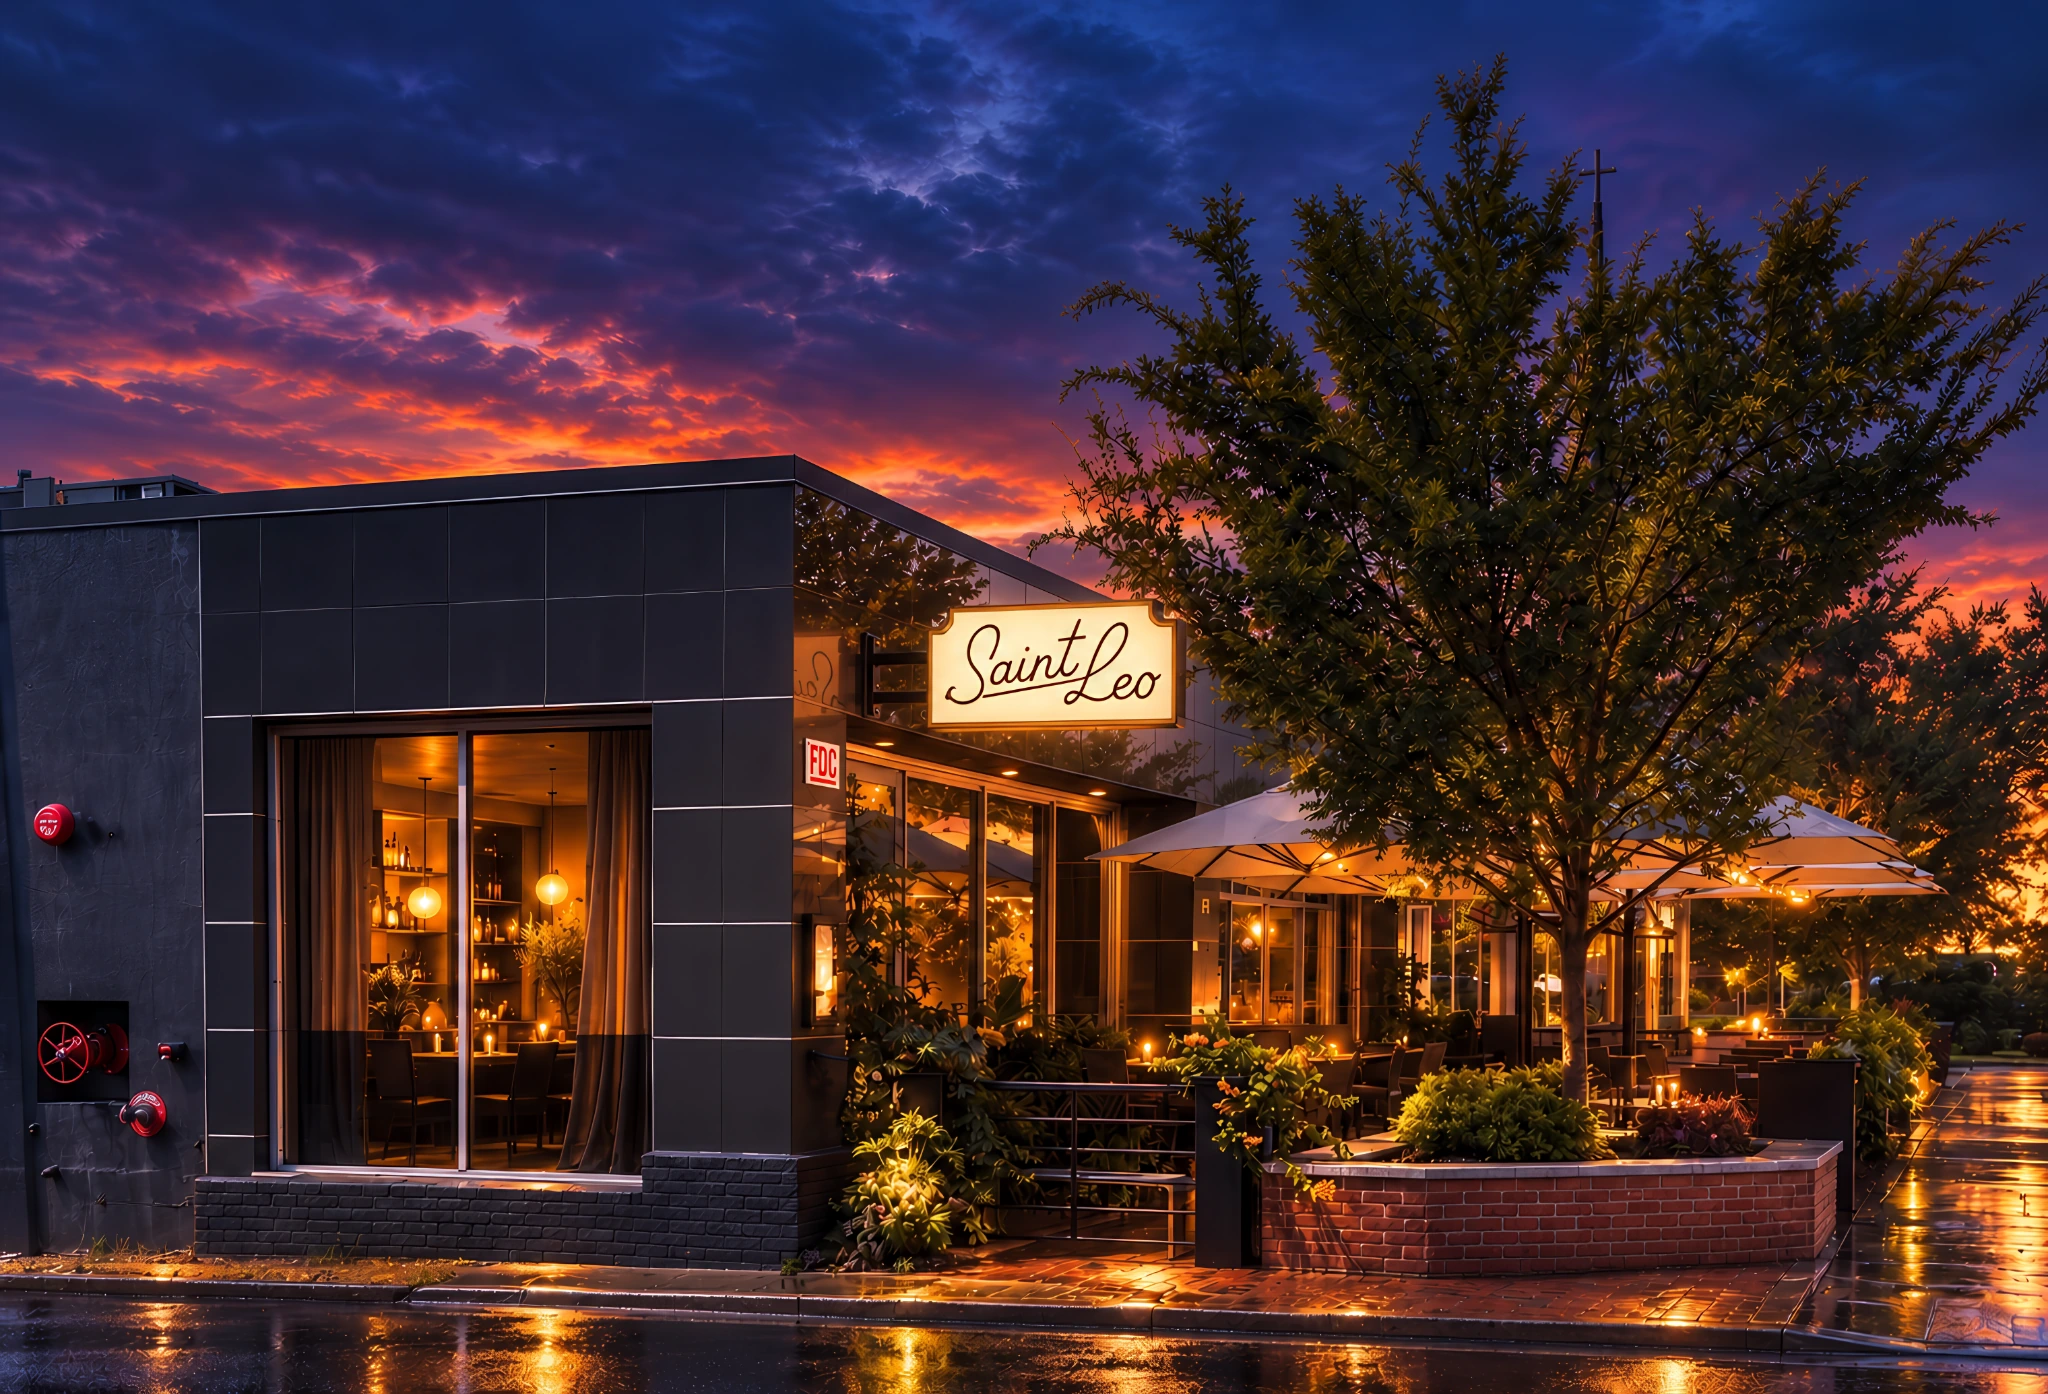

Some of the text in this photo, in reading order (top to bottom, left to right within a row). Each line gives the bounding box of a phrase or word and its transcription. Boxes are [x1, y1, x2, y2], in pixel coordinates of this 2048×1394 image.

[945, 618, 1162, 705] Saint Leo
[810, 744, 837, 779] FDC
